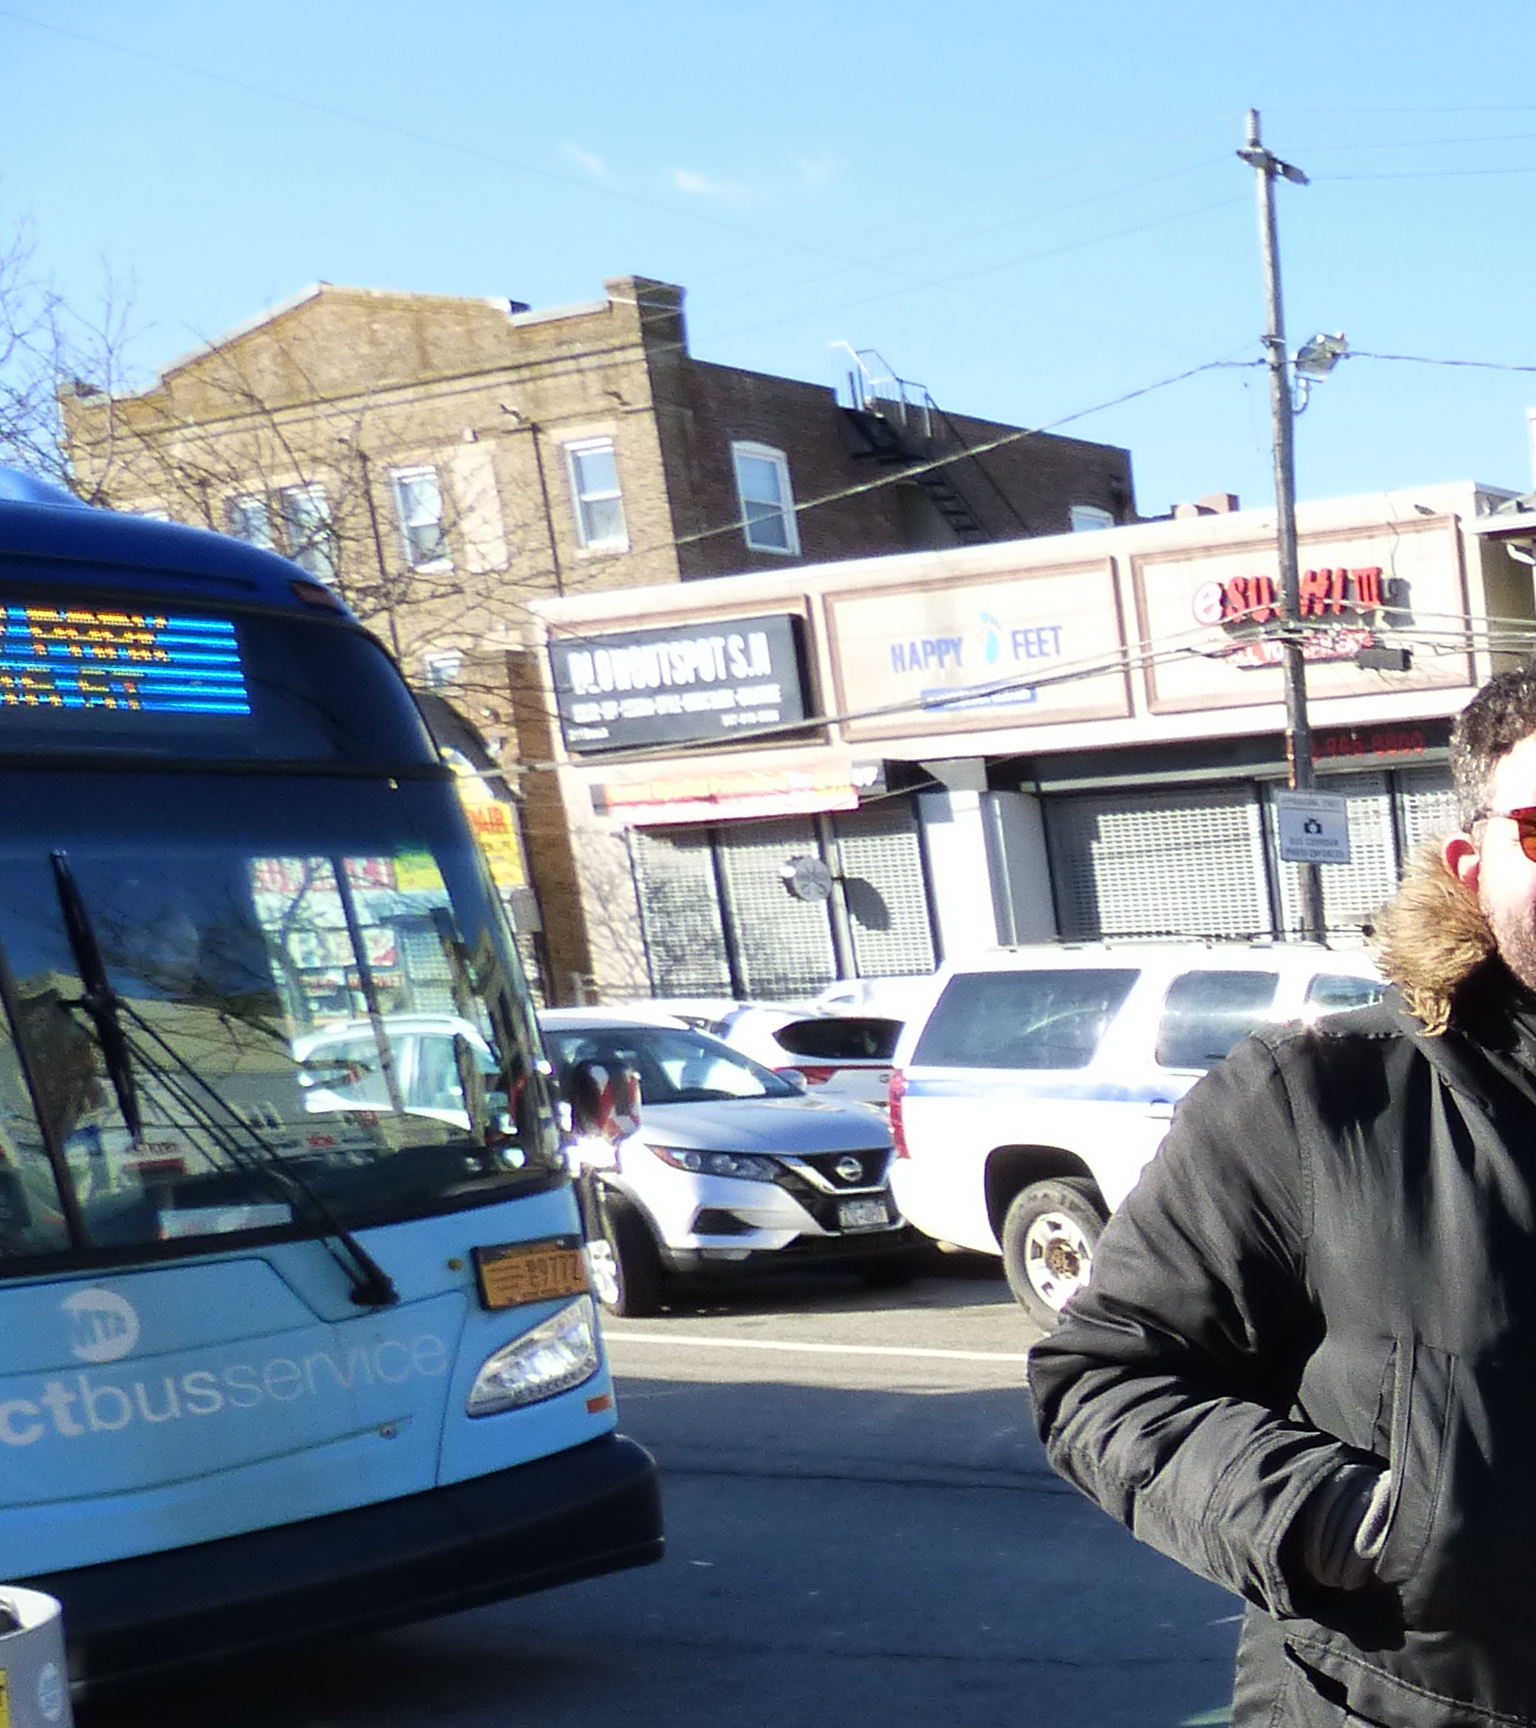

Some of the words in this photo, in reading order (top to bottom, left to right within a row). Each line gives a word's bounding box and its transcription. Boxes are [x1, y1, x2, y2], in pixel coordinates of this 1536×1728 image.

[1224, 568, 1350, 624] SUHI
[891, 636, 963, 673] HAPPY
[1011, 625, 1063, 660] FEET
